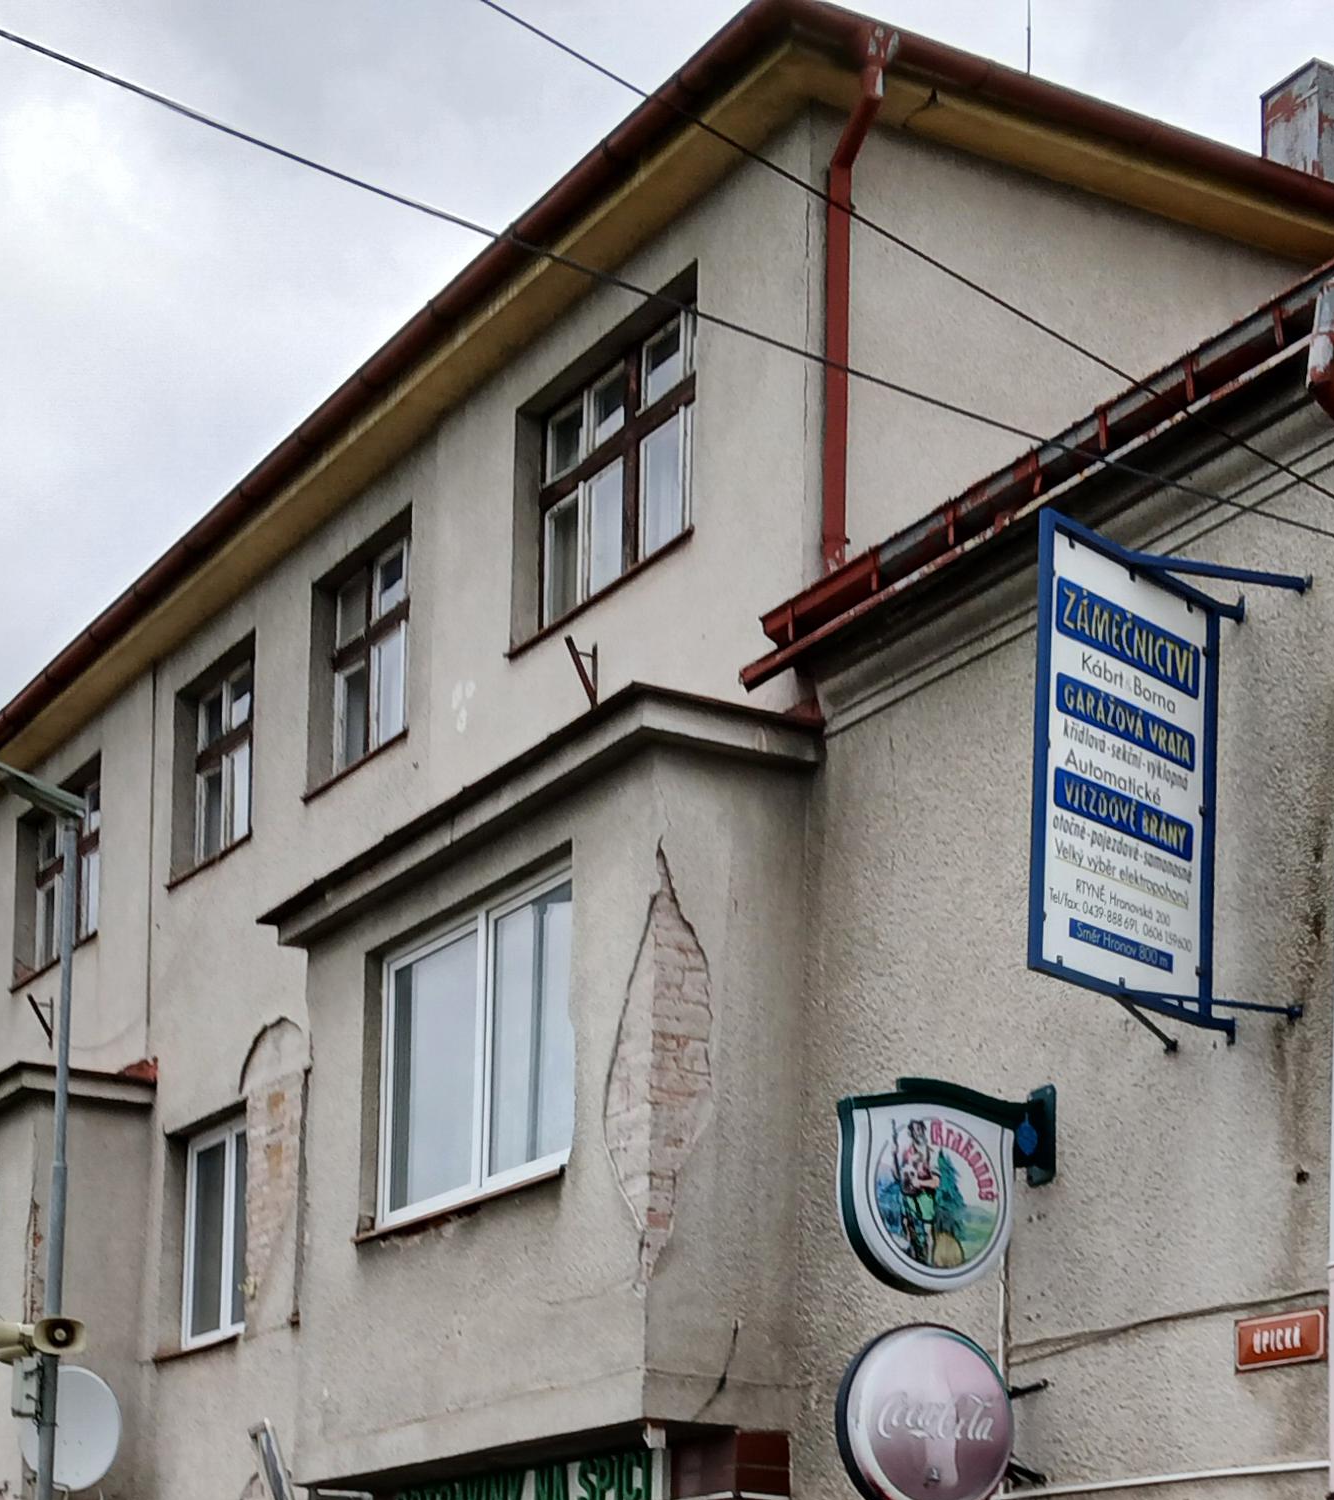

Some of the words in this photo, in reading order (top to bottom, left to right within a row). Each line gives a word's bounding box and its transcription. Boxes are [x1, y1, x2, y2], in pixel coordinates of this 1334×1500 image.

[1062, 586, 1195, 691] ZÁMEČNICTVÍ
[1081, 651, 1124, 689] Kábrt
[1133, 675, 1177, 714] Borna
[1063, 684, 1145, 741] GARÁŽOVÁ
[1148, 719, 1191, 765] VRATA
[1065, 748, 1162, 806] Automatické
[1054, 838, 1084, 867] Velký
[1087, 854, 1116, 877] výběr
[1142, 808, 1187, 853] BRÁNY
[1102, 932, 1137, 957] Hronov
